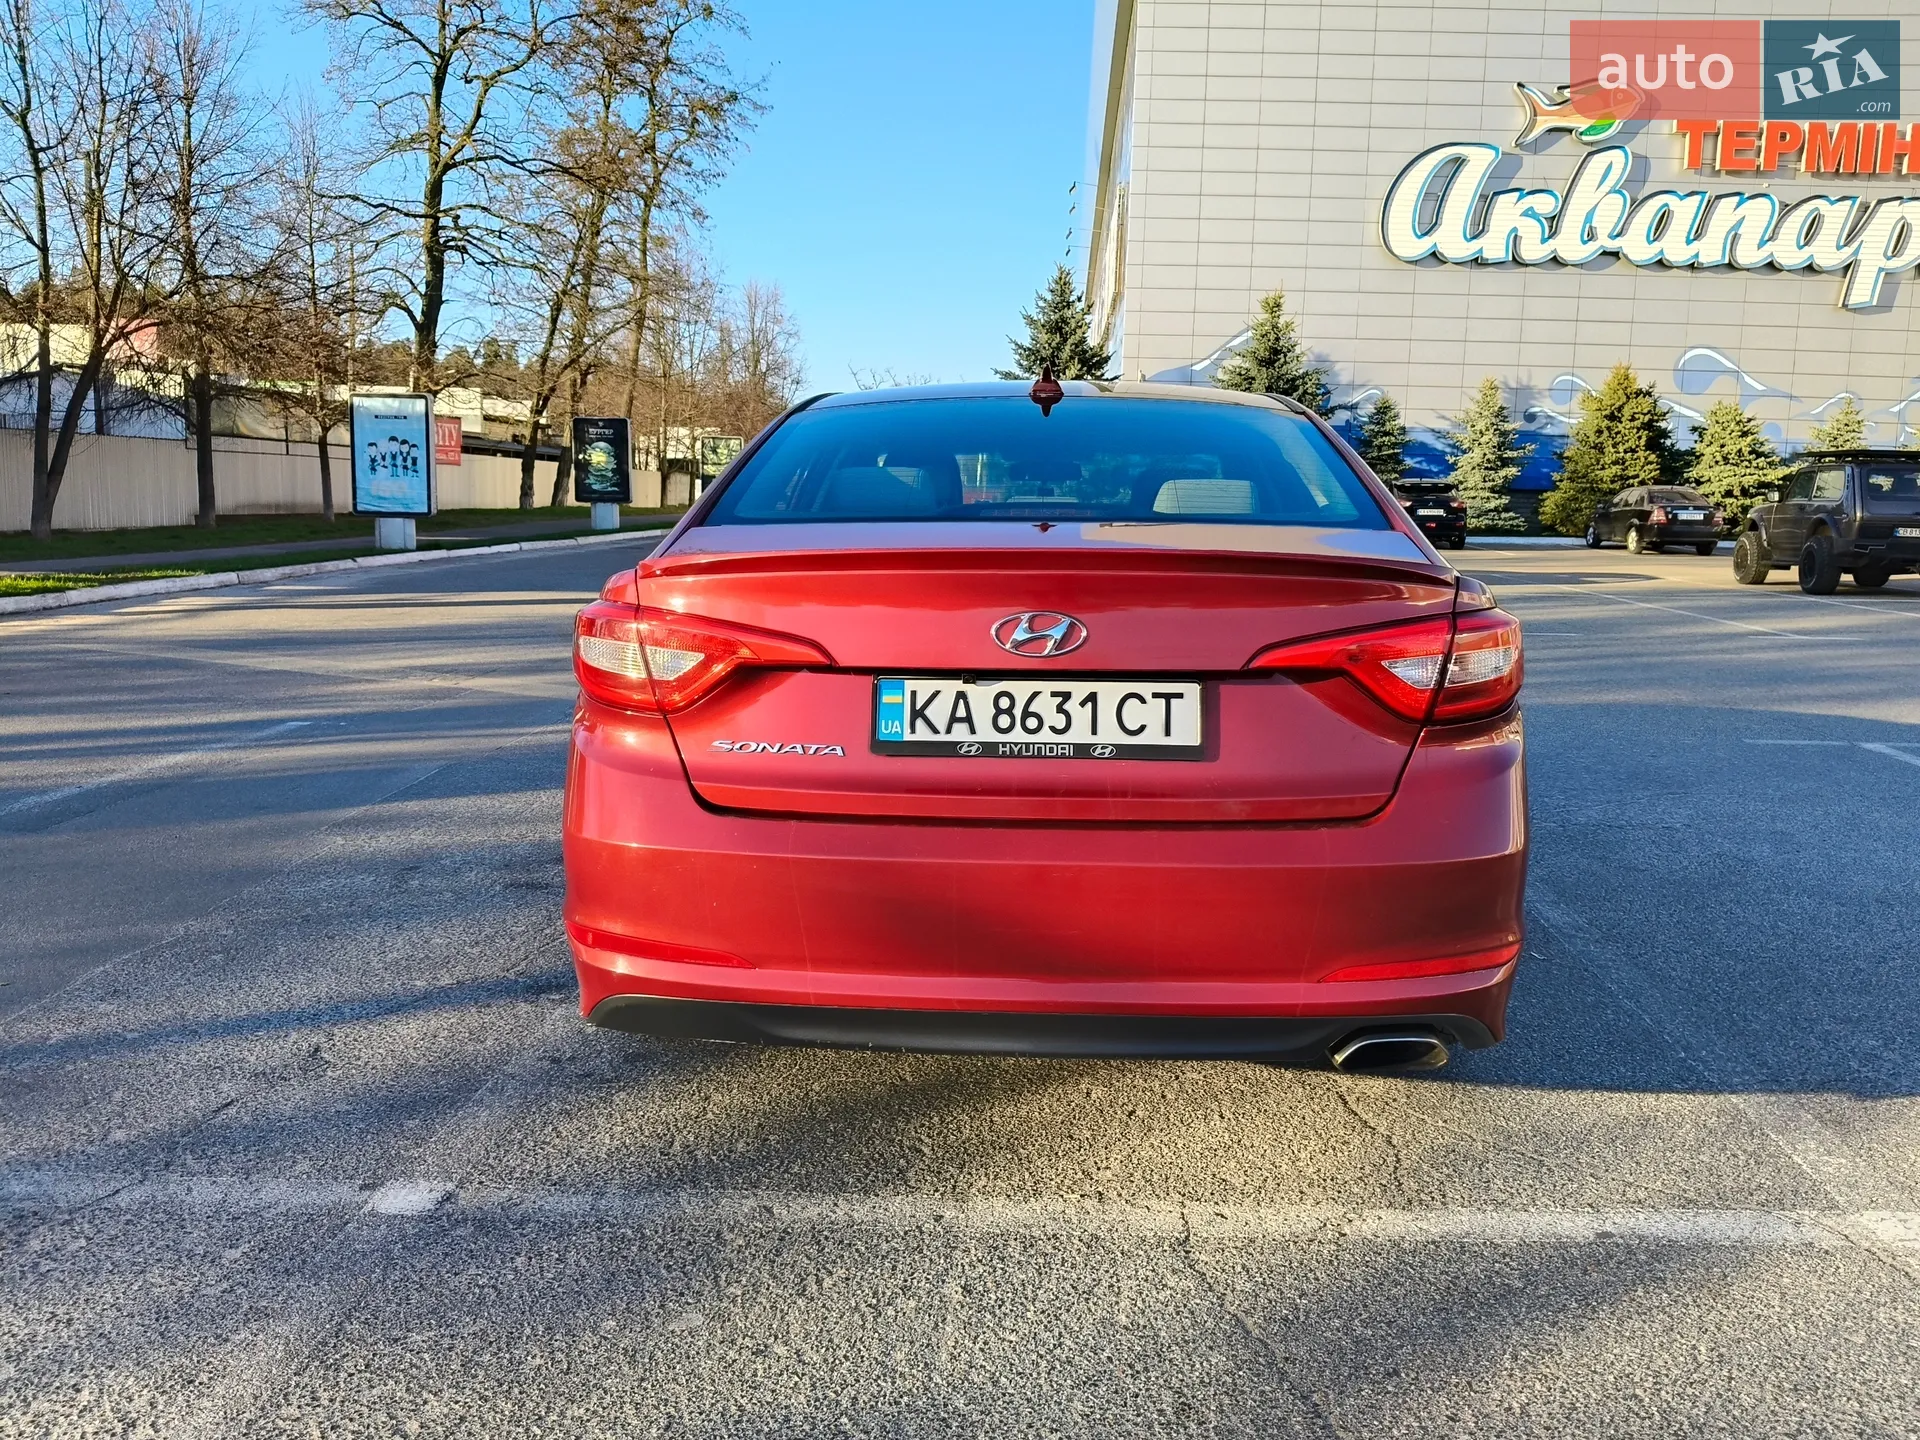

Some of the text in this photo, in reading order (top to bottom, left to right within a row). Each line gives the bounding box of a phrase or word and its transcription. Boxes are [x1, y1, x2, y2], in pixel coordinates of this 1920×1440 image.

[1673, 118, 1920, 174] ТЕРМІН
[1379, 142, 1920, 309] Аквапар
[880, 718, 902, 735] UA
[908, 689, 1185, 737] KA 8631 CT
[707, 739, 846, 757] SONATA
[998, 743, 1075, 757] HYUNDAI
